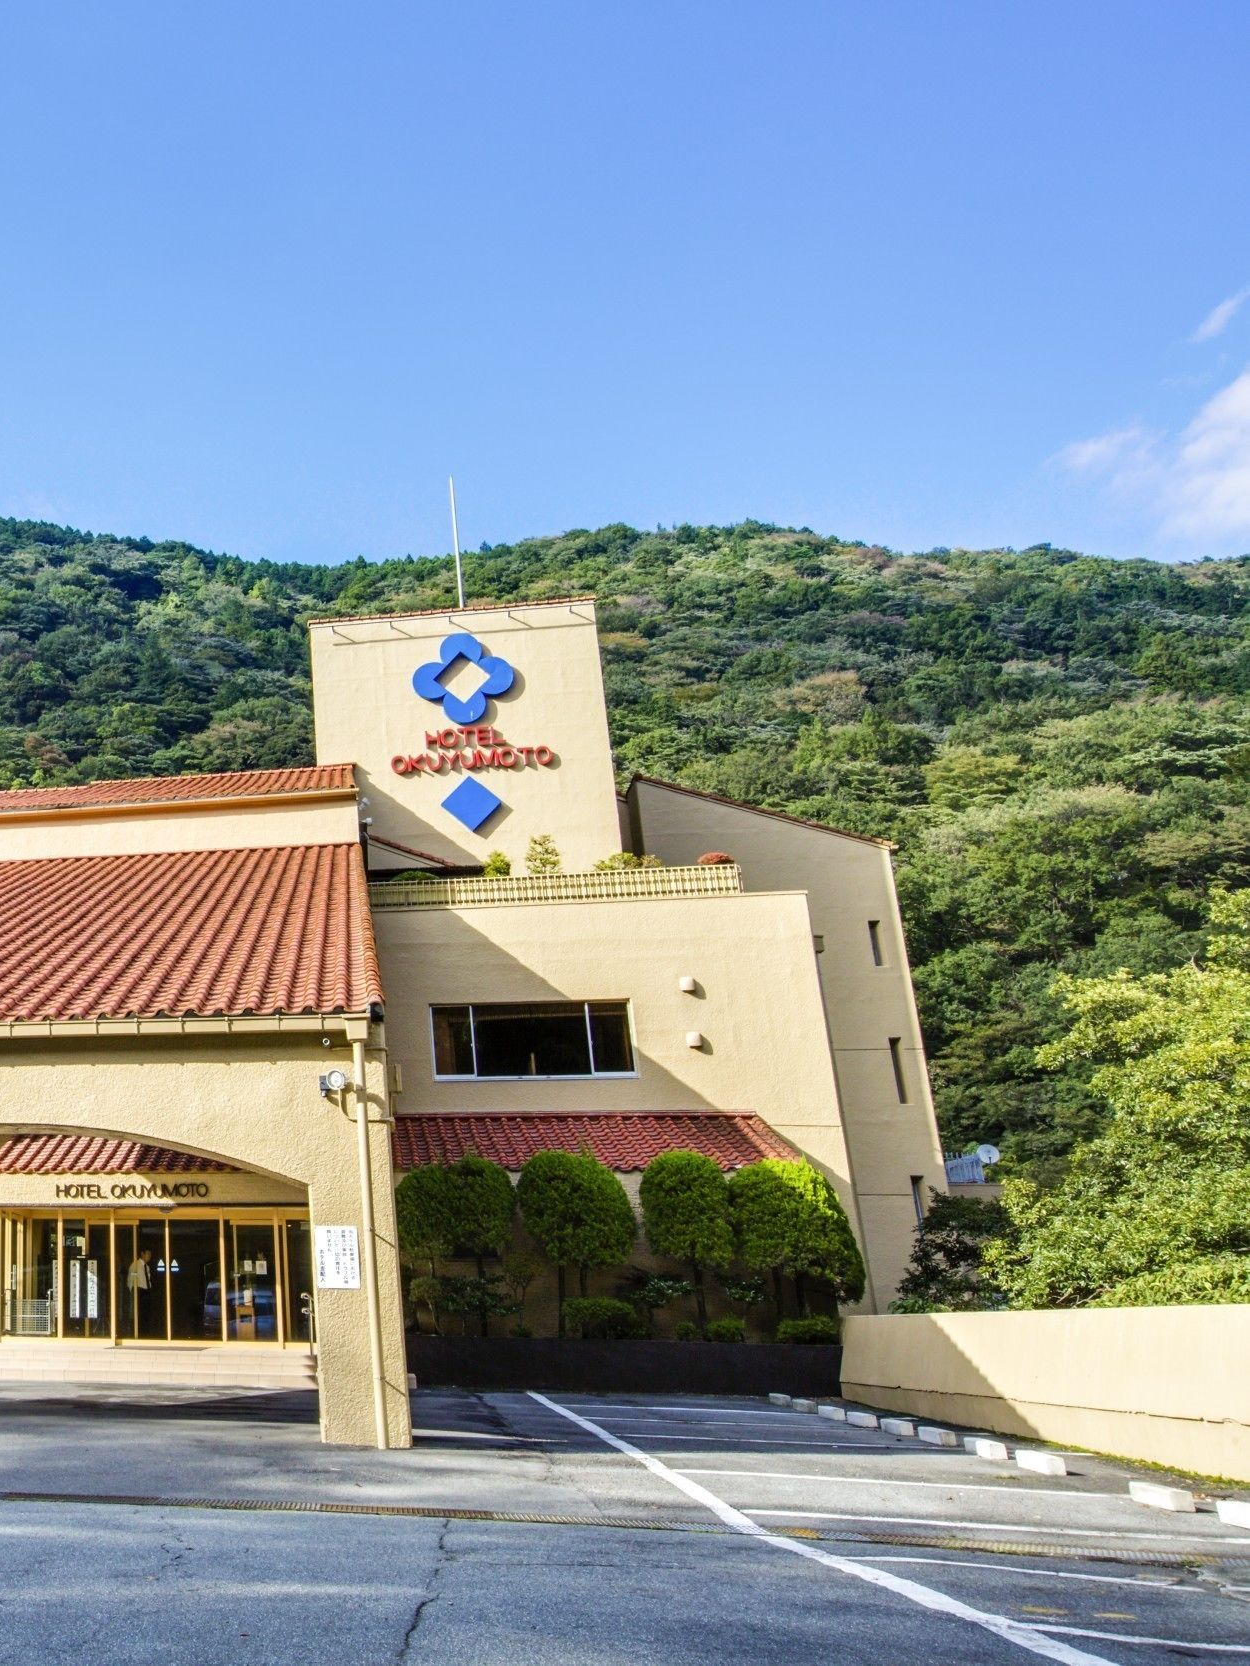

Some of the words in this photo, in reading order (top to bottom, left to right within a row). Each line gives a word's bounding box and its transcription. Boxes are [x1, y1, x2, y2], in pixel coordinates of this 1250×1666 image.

[424, 726, 507, 749] HOTEL
[390, 745, 554, 775] OKUYUMOTO
[55, 1184, 107, 1199] HOTEL
[111, 1183, 209, 1199] OKUYUMOTO
